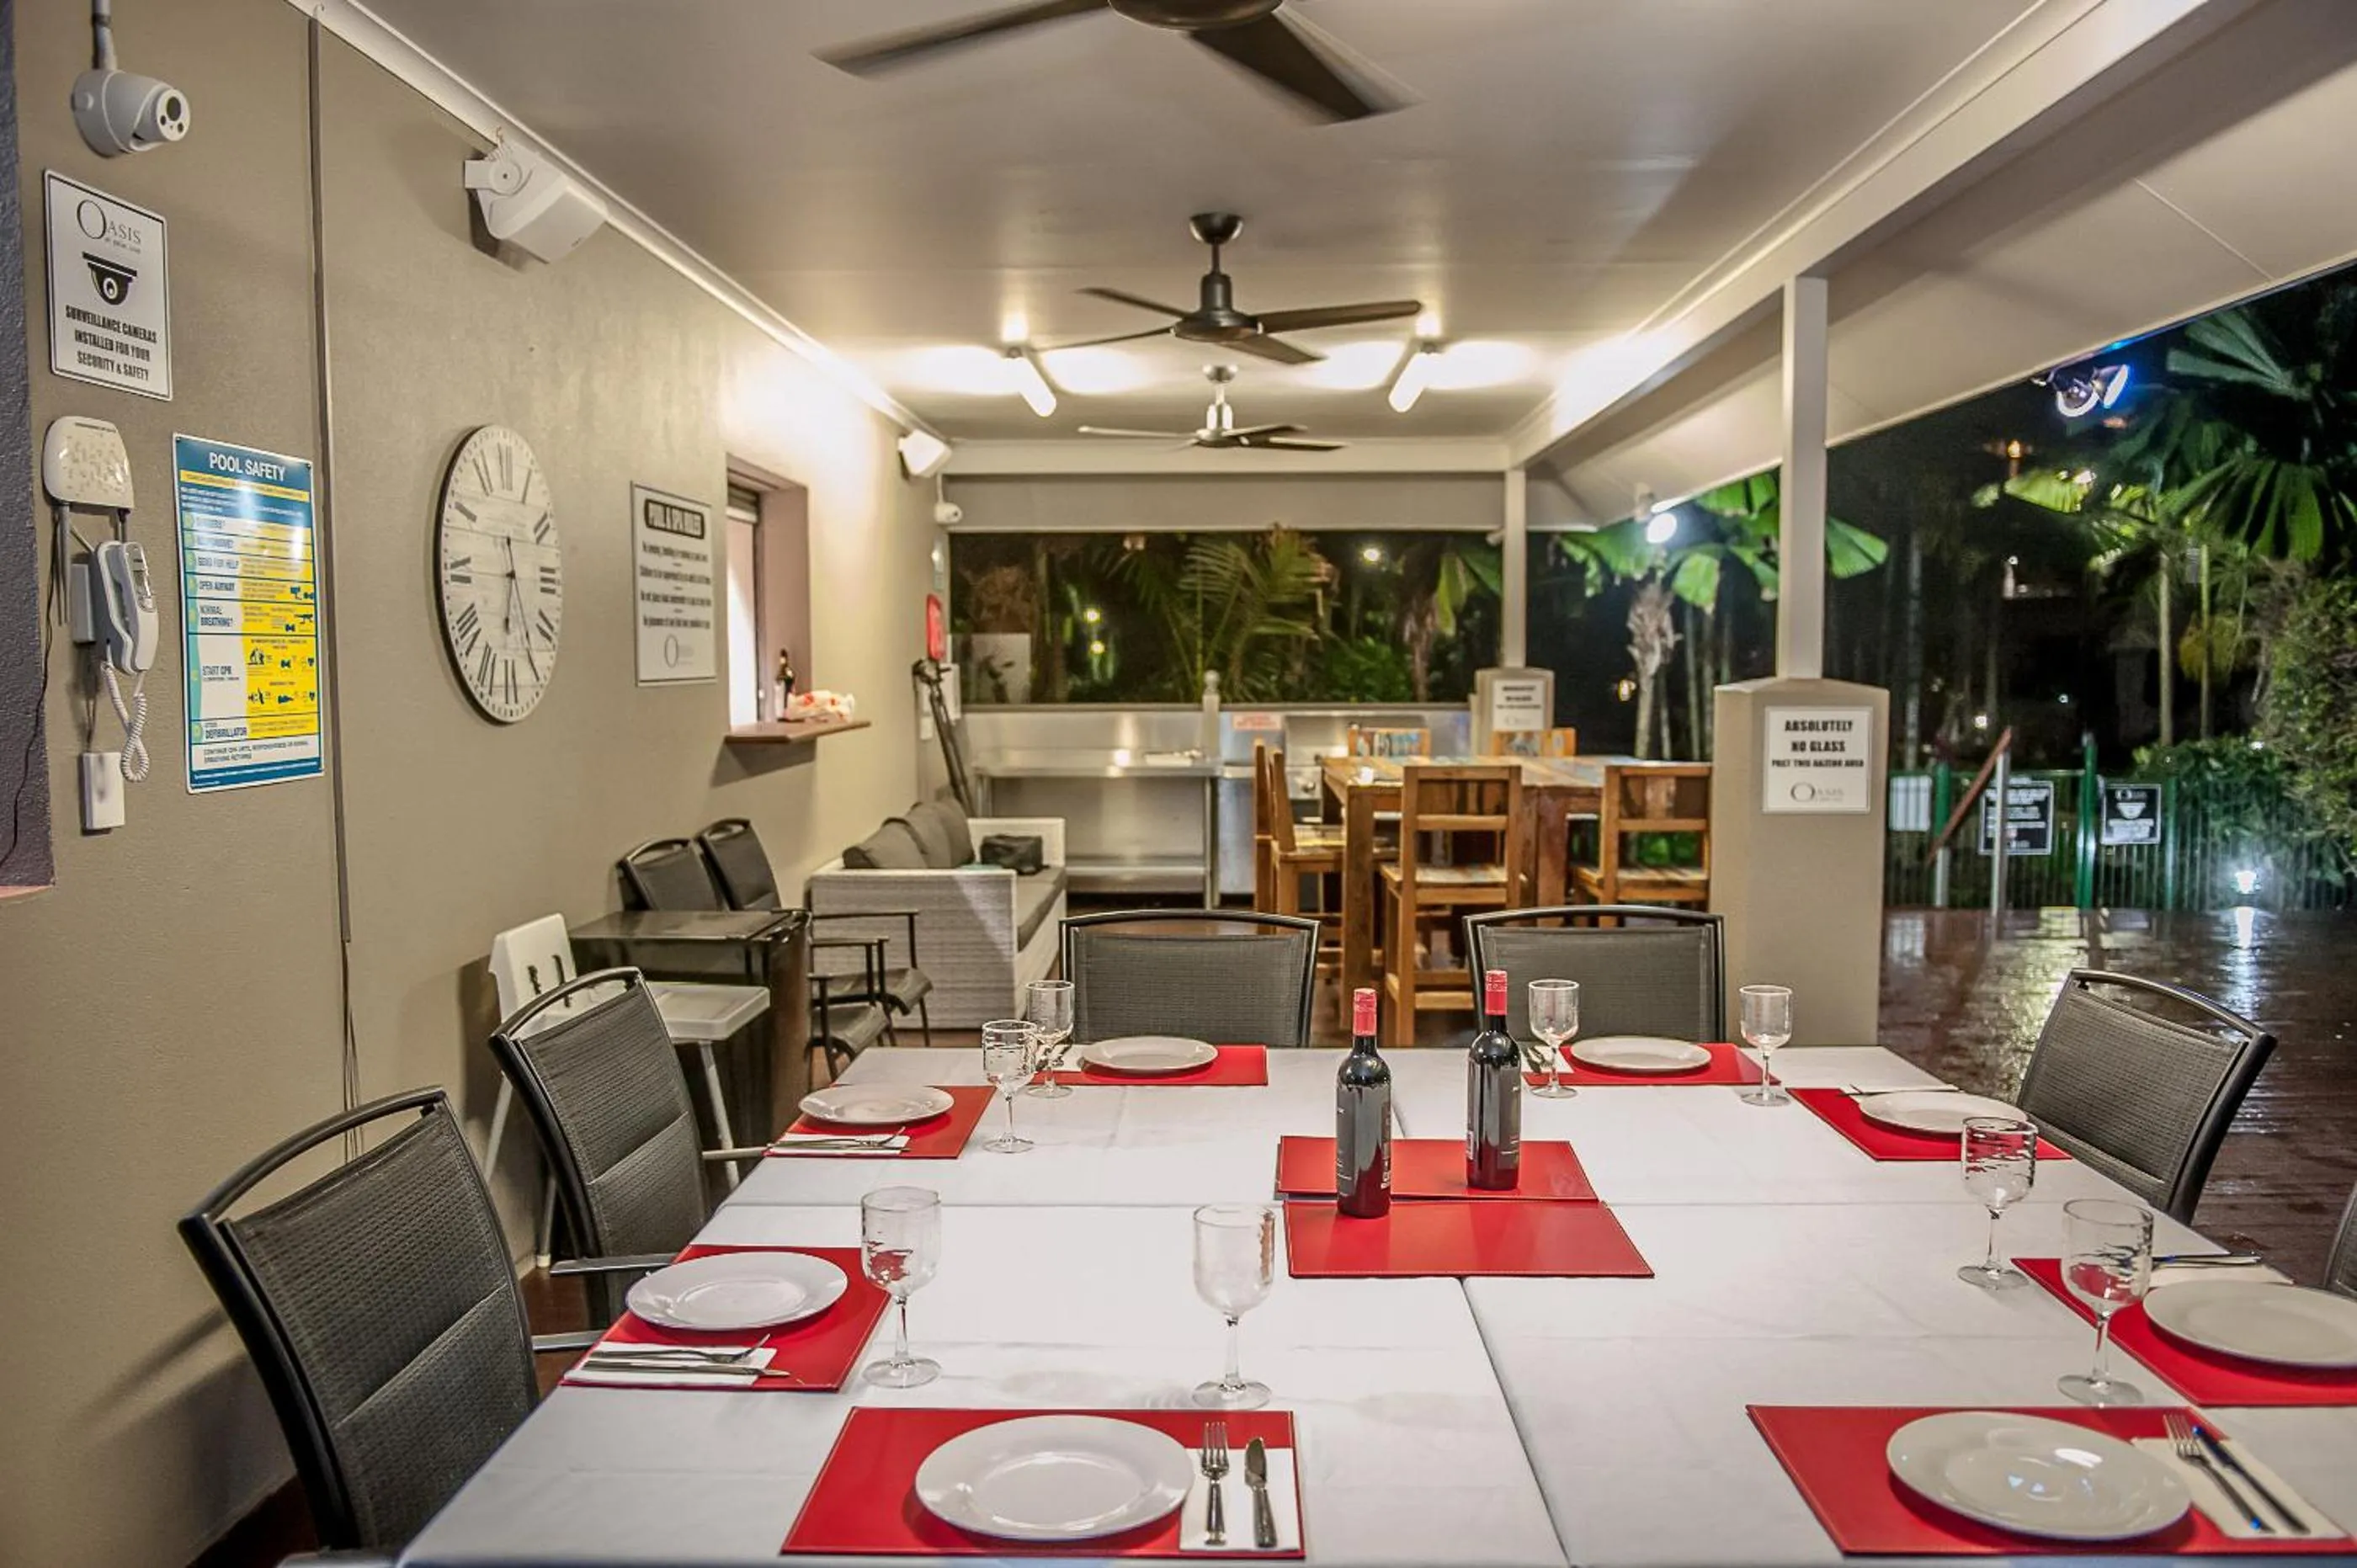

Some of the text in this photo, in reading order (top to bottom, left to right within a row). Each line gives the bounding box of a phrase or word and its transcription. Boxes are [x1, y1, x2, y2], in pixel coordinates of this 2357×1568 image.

[77, 199, 141, 245] OASIS
[66, 305, 157, 343] SURVEILLANCE CAMERAS
[74, 329, 151, 362] INSTALLED FOR YOUR
[77, 350, 149, 381] SECURITY & SAFETY
[209, 452, 285, 481] POOL SAFETY
[1785, 720, 1854, 731] ABSOLUTELY
[1790, 741, 1846, 752] NO GLASS
